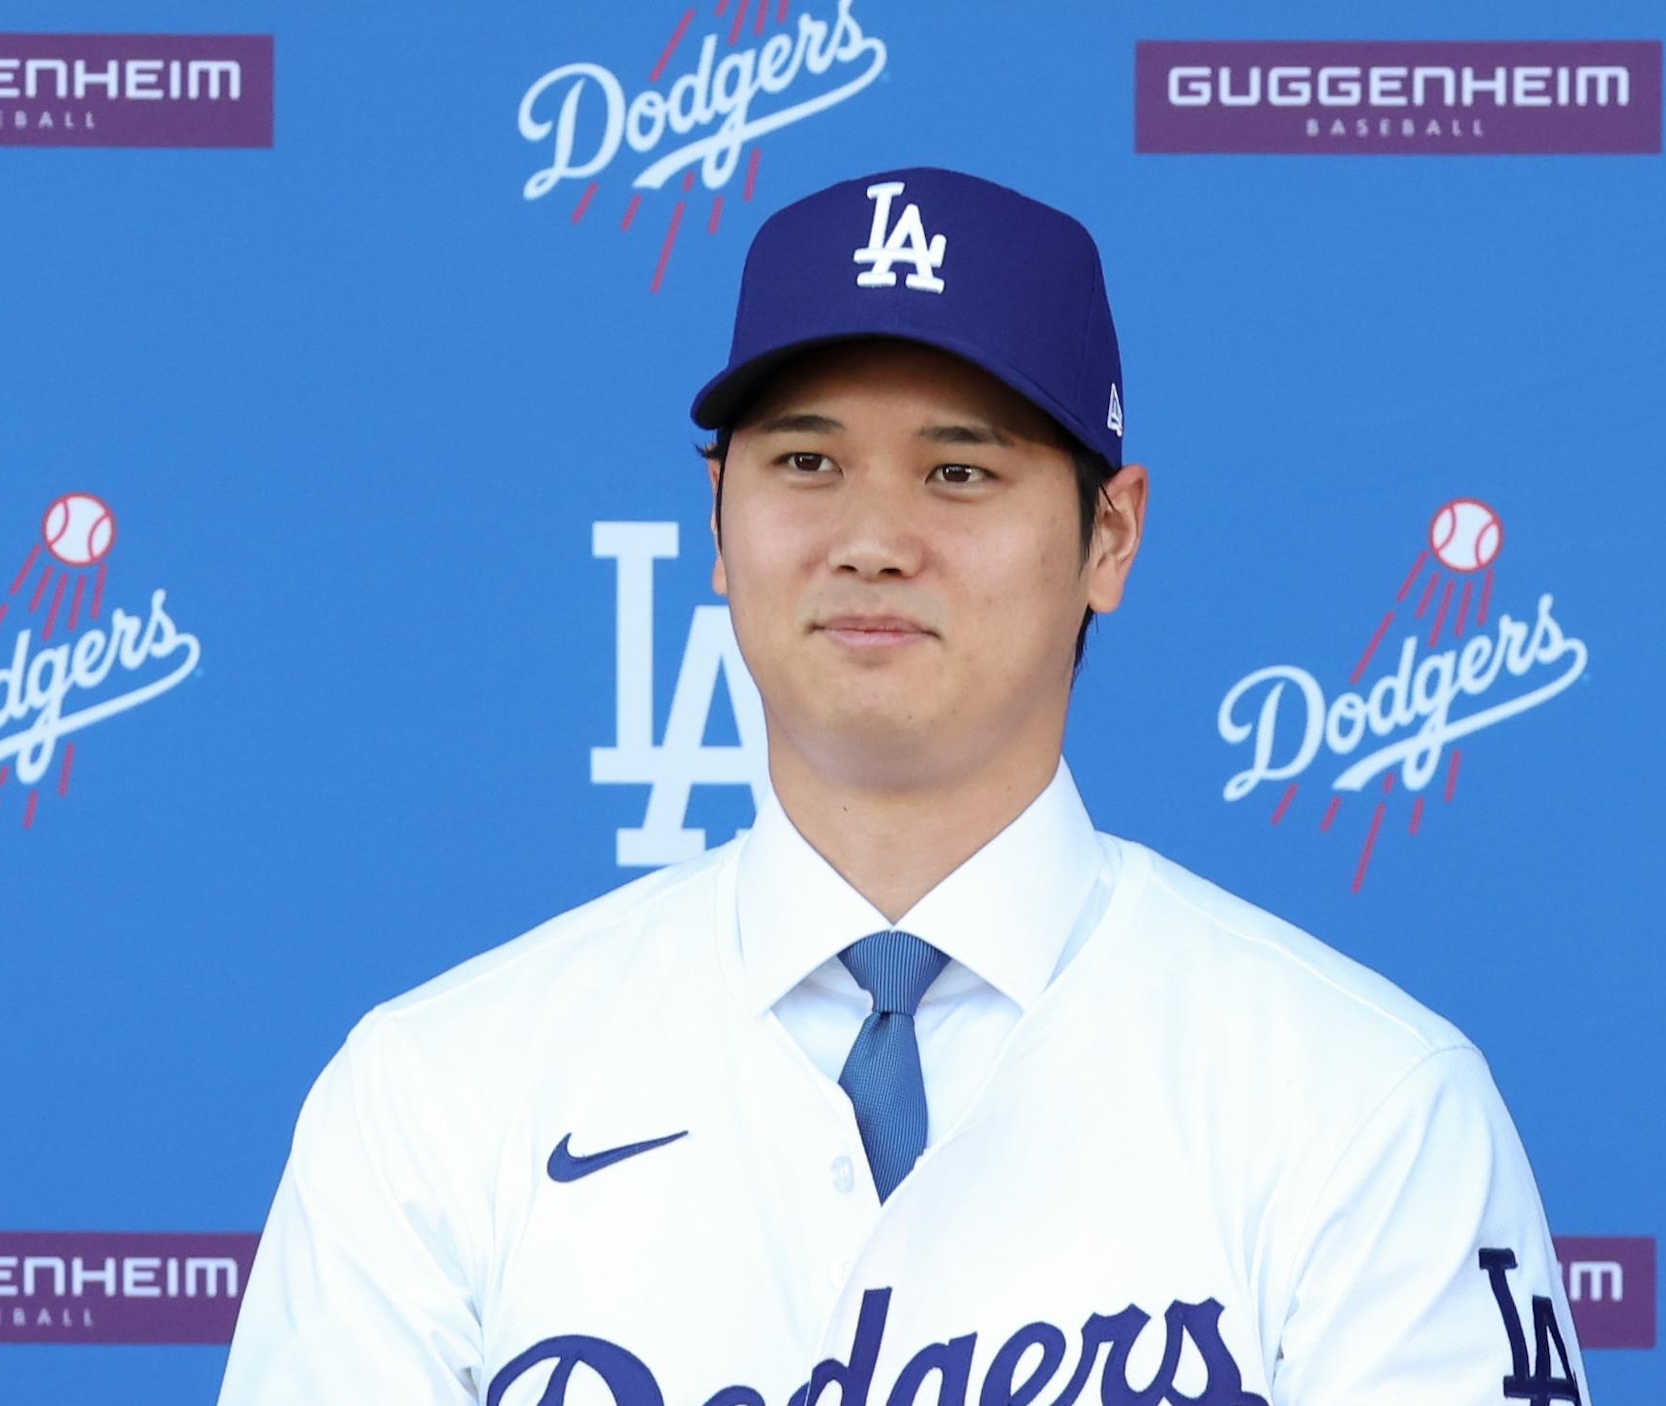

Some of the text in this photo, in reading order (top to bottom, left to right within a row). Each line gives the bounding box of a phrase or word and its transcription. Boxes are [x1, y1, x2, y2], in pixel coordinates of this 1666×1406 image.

[517, 0, 888, 200] Dodgers
[1167, 65, 1630, 108] GUGGENHEIM
[1305, 117, 1486, 138] BASEBALL
[853, 181, 947, 294] LA
[1217, 593, 1588, 802] Dodgers
